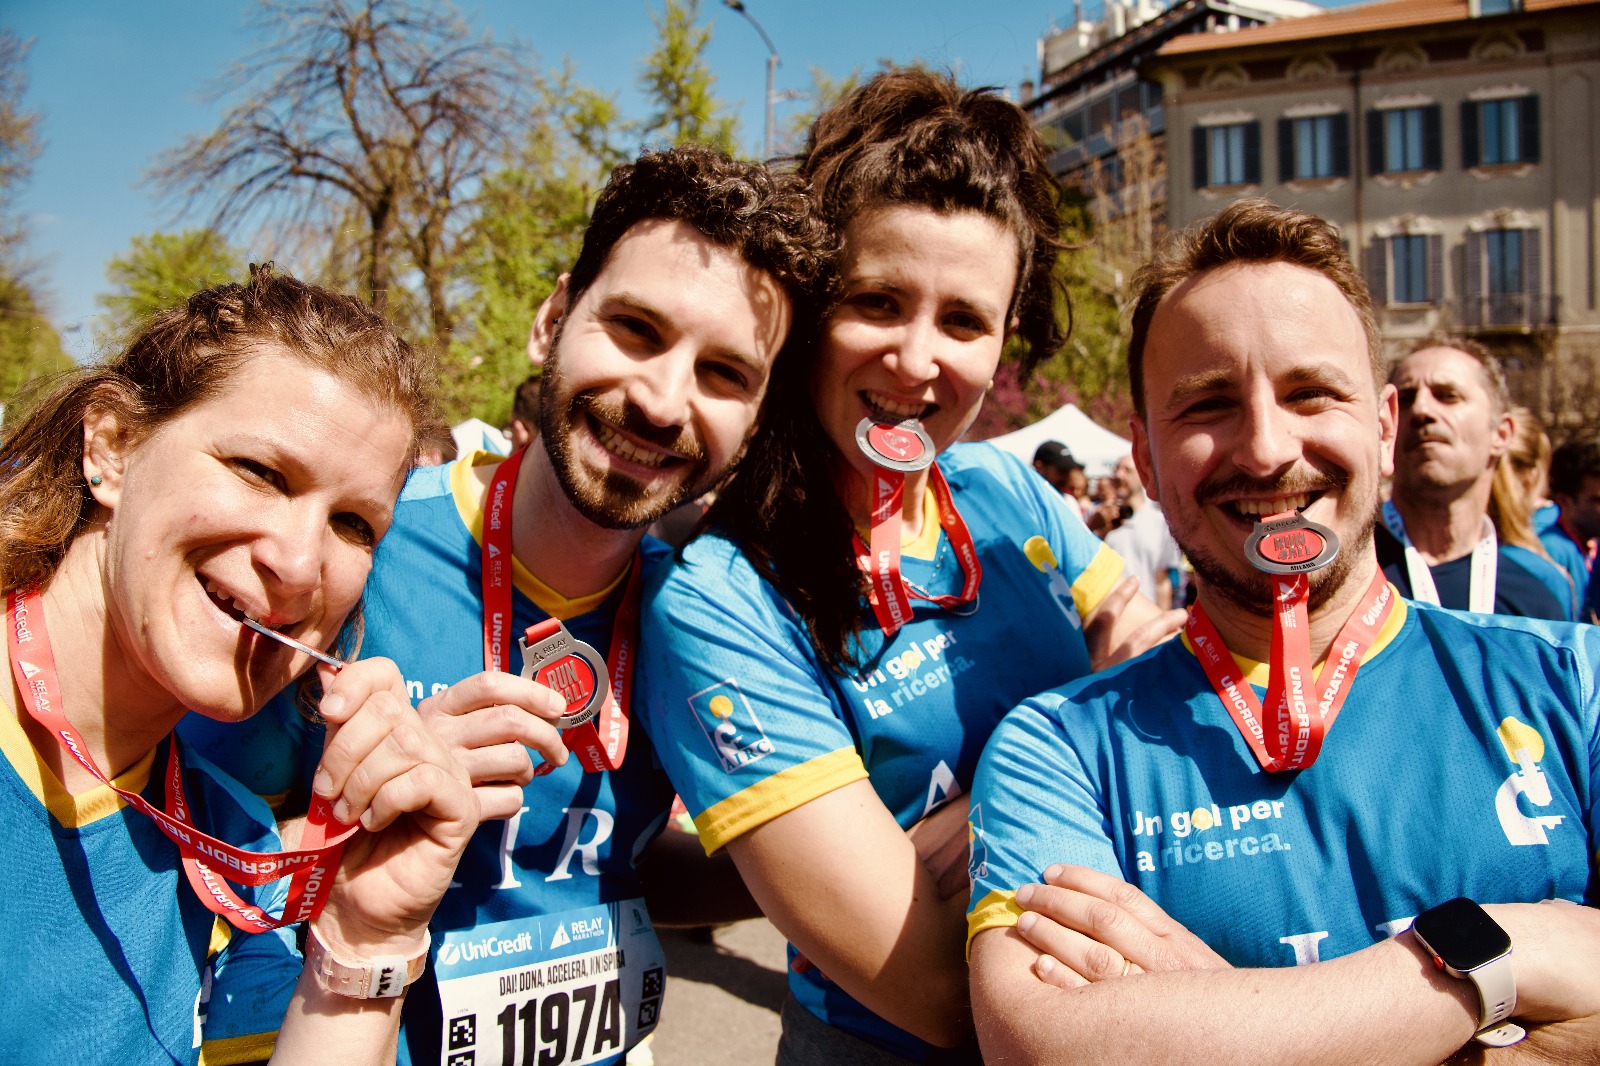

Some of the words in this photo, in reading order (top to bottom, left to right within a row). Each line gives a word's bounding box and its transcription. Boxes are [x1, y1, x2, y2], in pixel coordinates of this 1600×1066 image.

[1273, 533, 1306, 551] RUN
[543, 637, 566, 653] RELAY
[922, 629, 958, 662] per
[547, 660, 578, 692] RUN
[863, 697, 893, 720] la
[890, 656, 975, 707] ricerca.
[34, 679, 51, 712] RELAY
[1290, 667, 1310, 764] UNICREDIT
[725, 741, 771, 771] AIRC
[1229, 800, 1285, 831] per
[196, 841, 320, 875] UNICREDIT
[1160, 832, 1292, 869] ricerca.
[571, 916, 603, 935] RELAY
[572, 929, 605, 941] MARATHON
[460, 931, 533, 962] UniCredit
[499, 973, 517, 996] DAI!
[519, 968, 545, 989] DONA,
[547, 958, 589, 986] ACCELERA,
[497, 978, 621, 1066] 1197A
